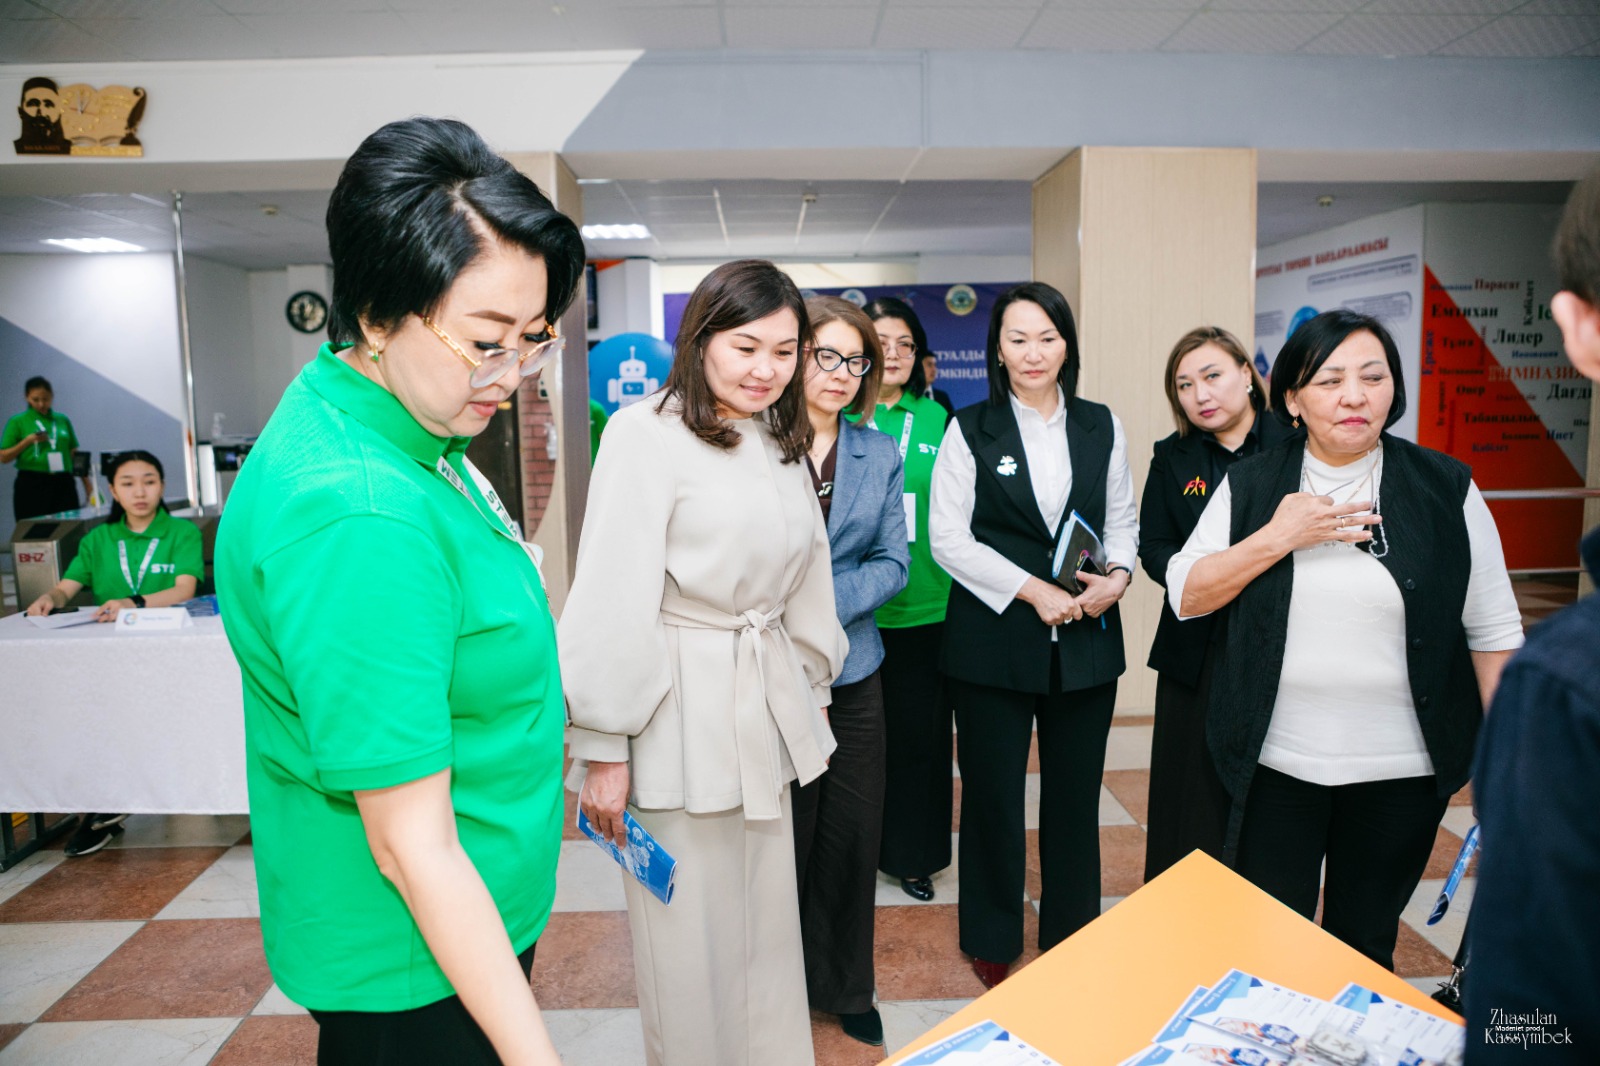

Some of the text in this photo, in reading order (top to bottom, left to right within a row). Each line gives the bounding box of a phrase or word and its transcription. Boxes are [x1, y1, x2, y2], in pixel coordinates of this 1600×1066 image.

[1432, 304, 1498, 318] Емтихан
[1492, 328, 1543, 348] Лидер
[933, 350, 986, 361] ТУАЛДЫ
[918, 442, 940, 456] ST
